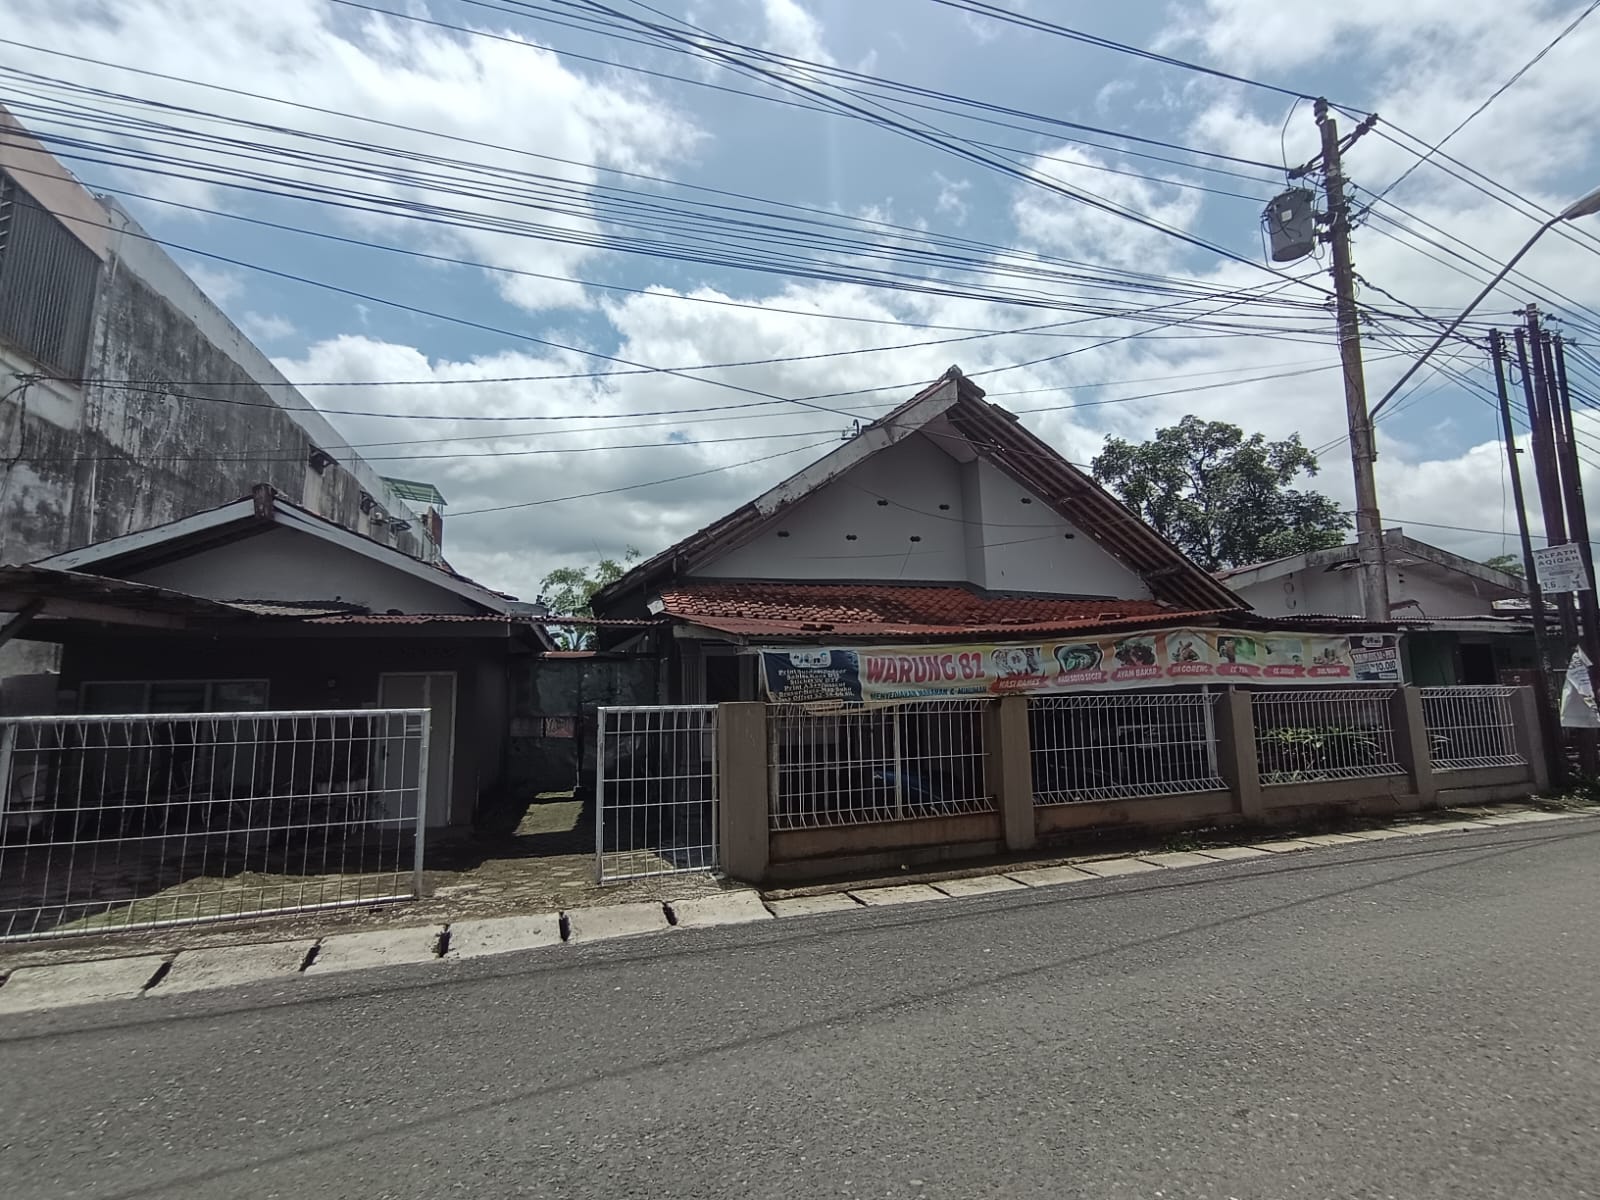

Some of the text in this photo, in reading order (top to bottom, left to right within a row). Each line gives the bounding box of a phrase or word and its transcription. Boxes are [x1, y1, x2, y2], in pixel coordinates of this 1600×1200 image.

[1538, 556, 1579, 566] AQIQAH
[866, 654, 957, 683] WARUNG
[1181, 665, 1209, 673] GORENG
[1117, 669, 1135, 679] AYAM
